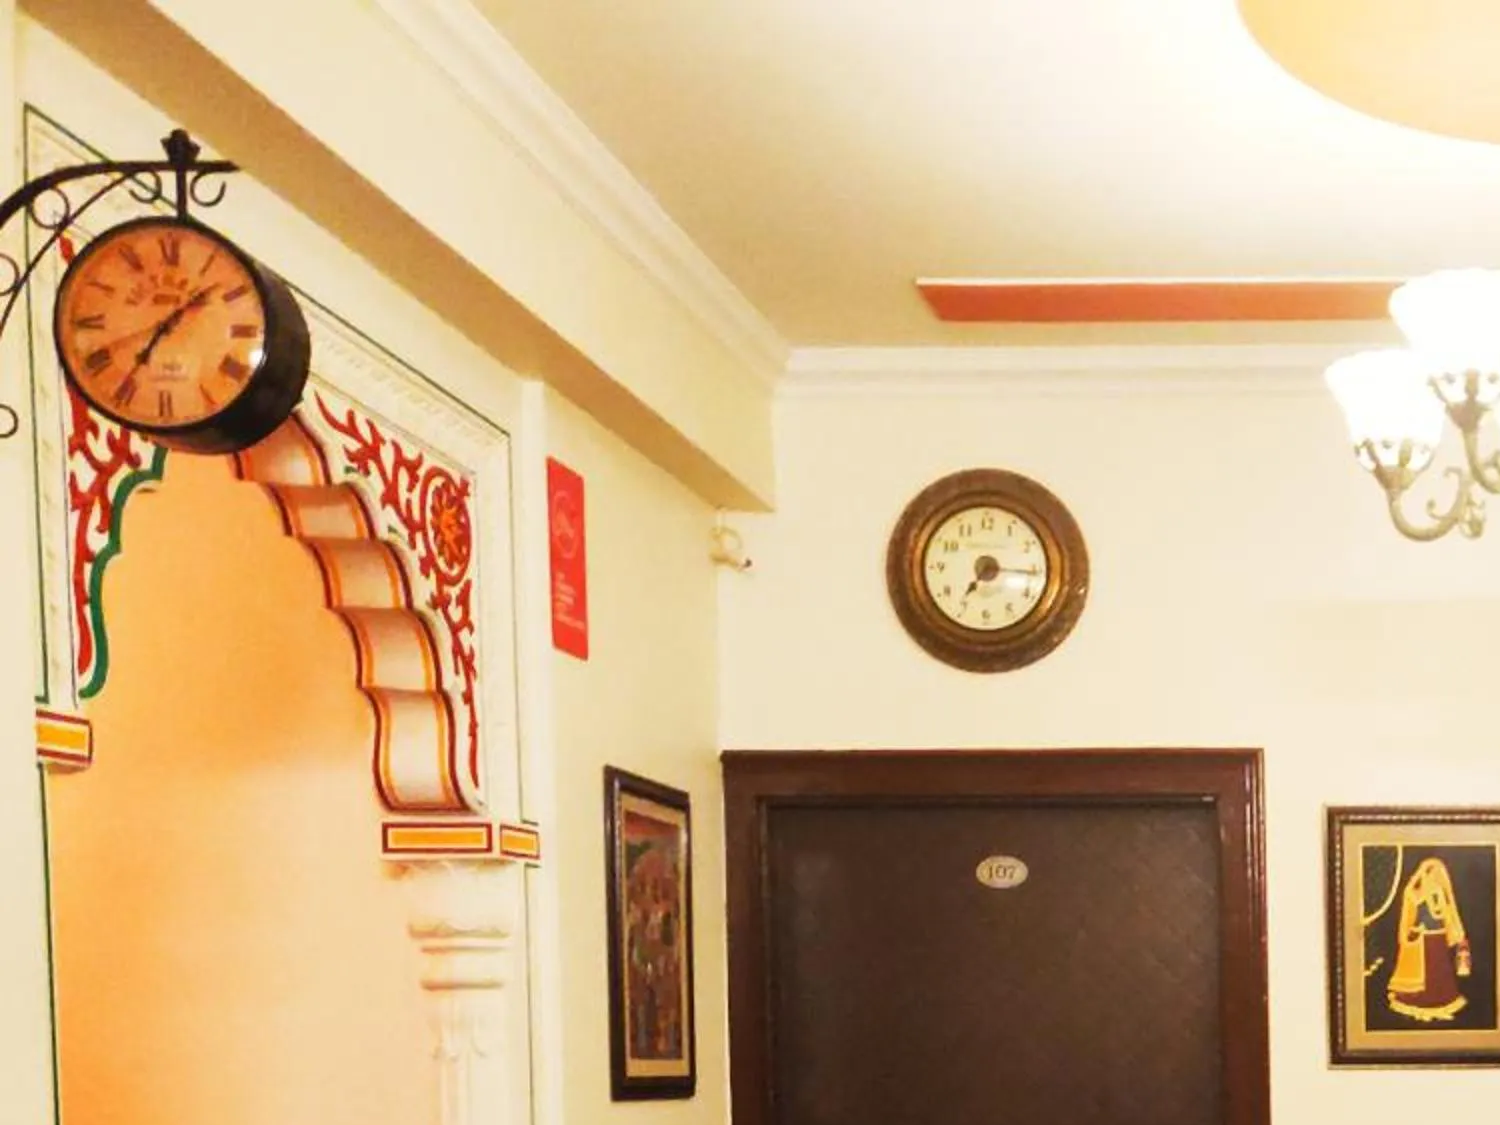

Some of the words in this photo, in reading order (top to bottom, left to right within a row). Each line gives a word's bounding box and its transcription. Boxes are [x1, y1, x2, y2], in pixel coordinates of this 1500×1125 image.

[981, 517, 994, 530] 12
[958, 524, 973, 537] 11
[943, 540, 960, 553] 10
[988, 863, 1016, 881] 107
